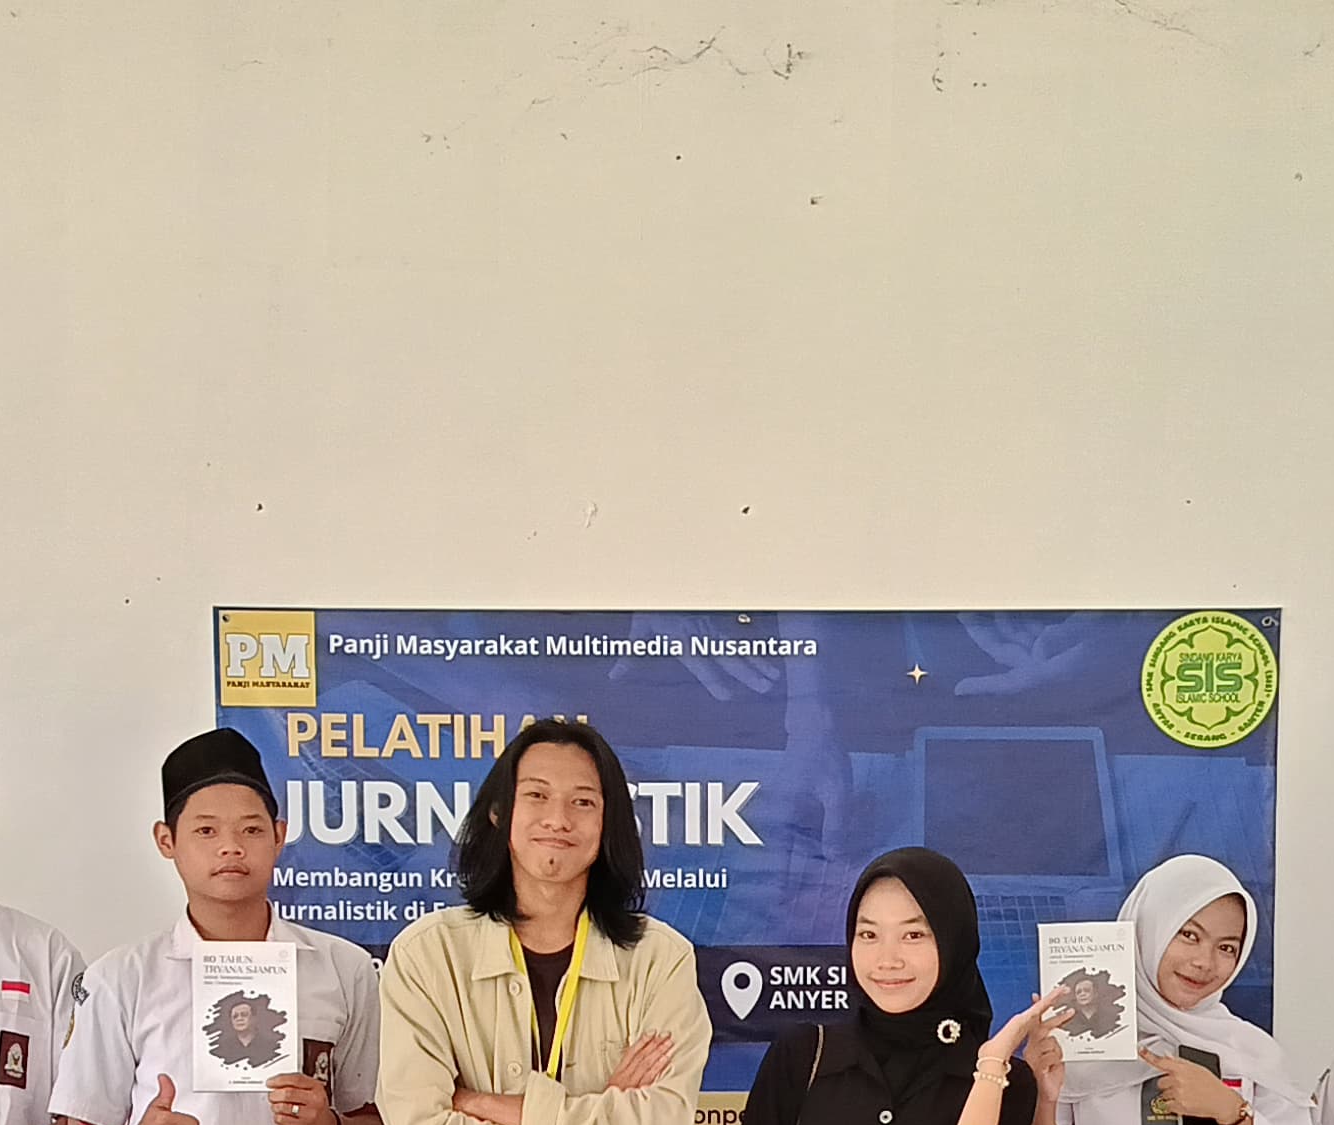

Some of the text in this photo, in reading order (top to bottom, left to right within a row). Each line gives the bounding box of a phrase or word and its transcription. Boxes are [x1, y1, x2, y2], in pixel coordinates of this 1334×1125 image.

[1177, 616, 1209, 632] KARYA
[1211, 616, 1249, 635] ISLAMIC
[225, 633, 311, 679] PM
[329, 634, 818, 661] Panji Masyarakat Multimedia Nusantara
[1179, 652, 1243, 663] SINDANG KARYA
[226, 681, 250, 689] PANJI
[1176, 660, 1244, 693] SIS
[1176, 692, 1241, 704] ISLAMIC SCHOOL
[287, 713, 588, 758] PELATIH
[286, 780, 764, 846] JURNTIK
[272, 866, 423, 892] Membangun
[641, 867, 728, 888] Melalui
[273, 900, 398, 921] Jurnalistik
[404, 900, 425, 921] di
[769, 966, 822, 986] SMK
[769, 990, 850, 1010] ANYER
